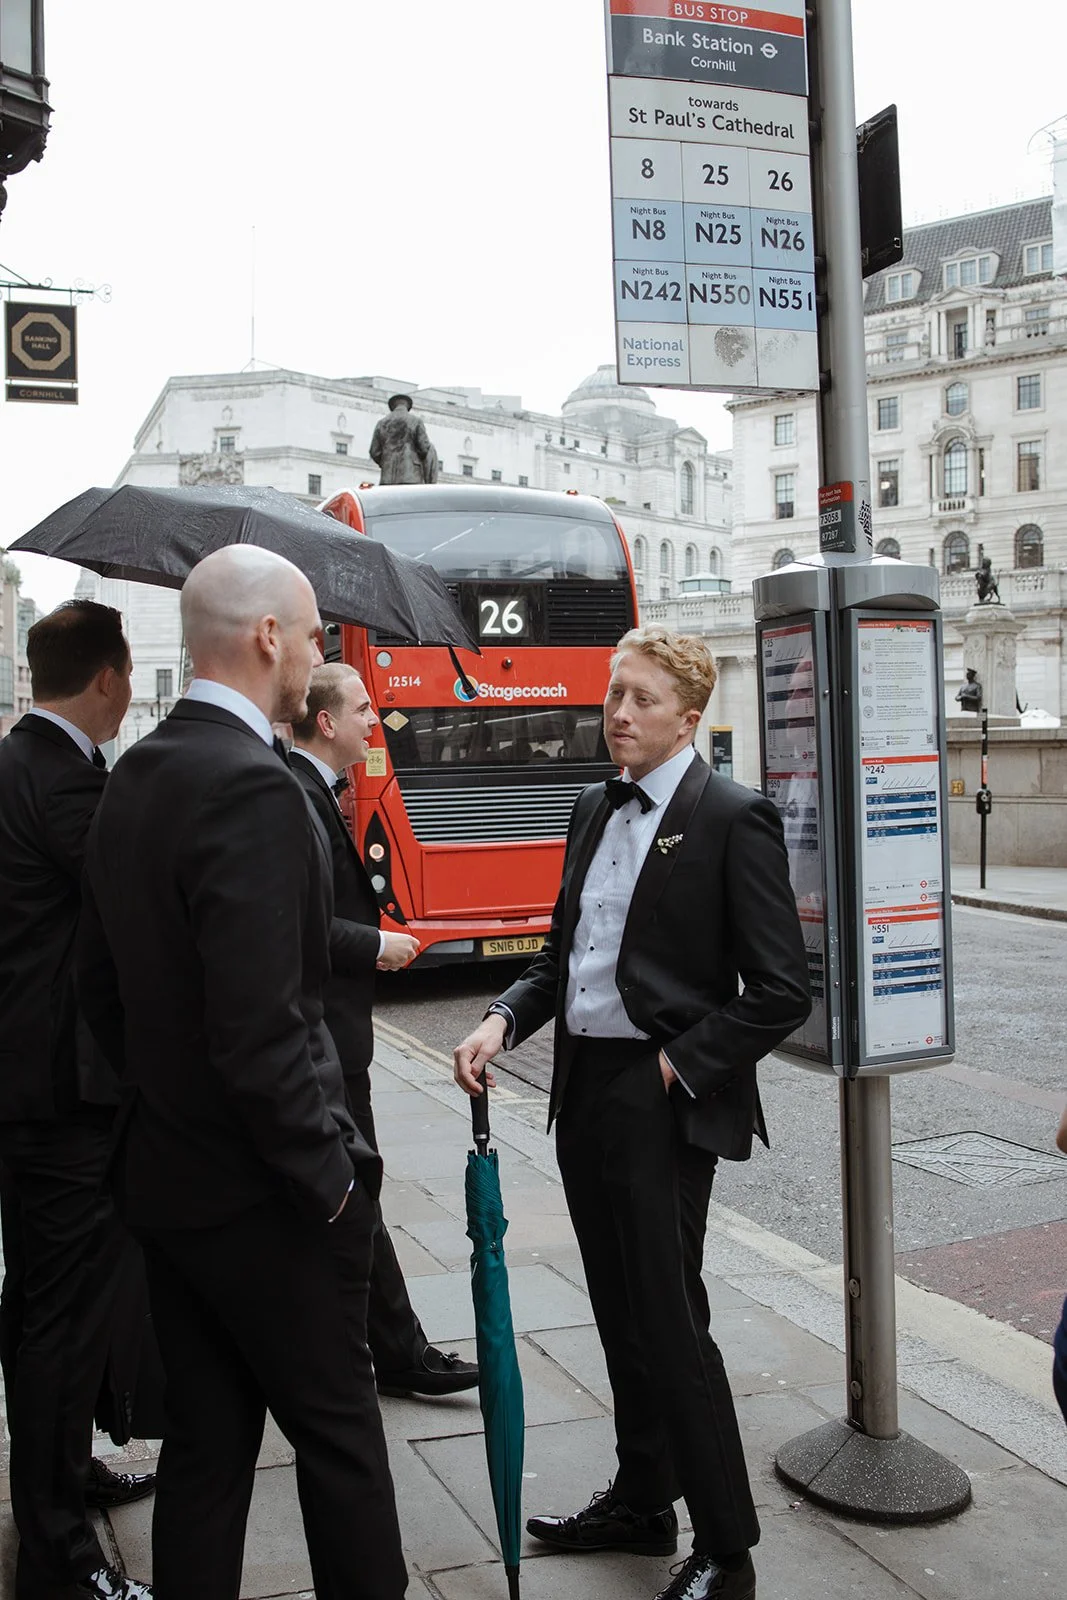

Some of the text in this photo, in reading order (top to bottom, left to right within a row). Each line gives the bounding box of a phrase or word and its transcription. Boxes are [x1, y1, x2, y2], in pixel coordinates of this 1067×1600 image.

[674, 3, 748, 24] BUS STOP
[643, 28, 753, 55] Bank Station
[690, 56, 737, 72] Cornhill
[688, 96, 739, 111] towards
[628, 107, 795, 139] St Paul's Cathedral
[641, 158, 655, 179] 8
[702, 163, 729, 186] 25
[767, 169, 794, 192] 26
[630, 206, 667, 216] Night Bus
[700, 211, 736, 220] Night Bus
[766, 216, 799, 227] Night Bus
[632, 218, 666, 241] N8
[695, 222, 742, 245] N25
[761, 228, 805, 251] N26
[632, 267, 669, 277] Night Bus
[701, 271, 722, 281] Night
[768, 276, 802, 286] Night Bus
[621, 280, 682, 301] N242
[689, 283, 750, 305] N550
[759, 287, 813, 311] N551
[24, 335, 58, 343] BANKING
[623, 337, 684, 352] National
[627, 353, 681, 368] Express
[19, 389, 64, 399] CORNHILL
[480, 600, 523, 634] 26
[388, 676, 421, 687] 12514
[478, 683, 567, 701] Stagecoach
[865, 765, 885, 774] N242
[872, 924, 890, 933] N551
[489, 939, 539, 953] SN16 OJD
